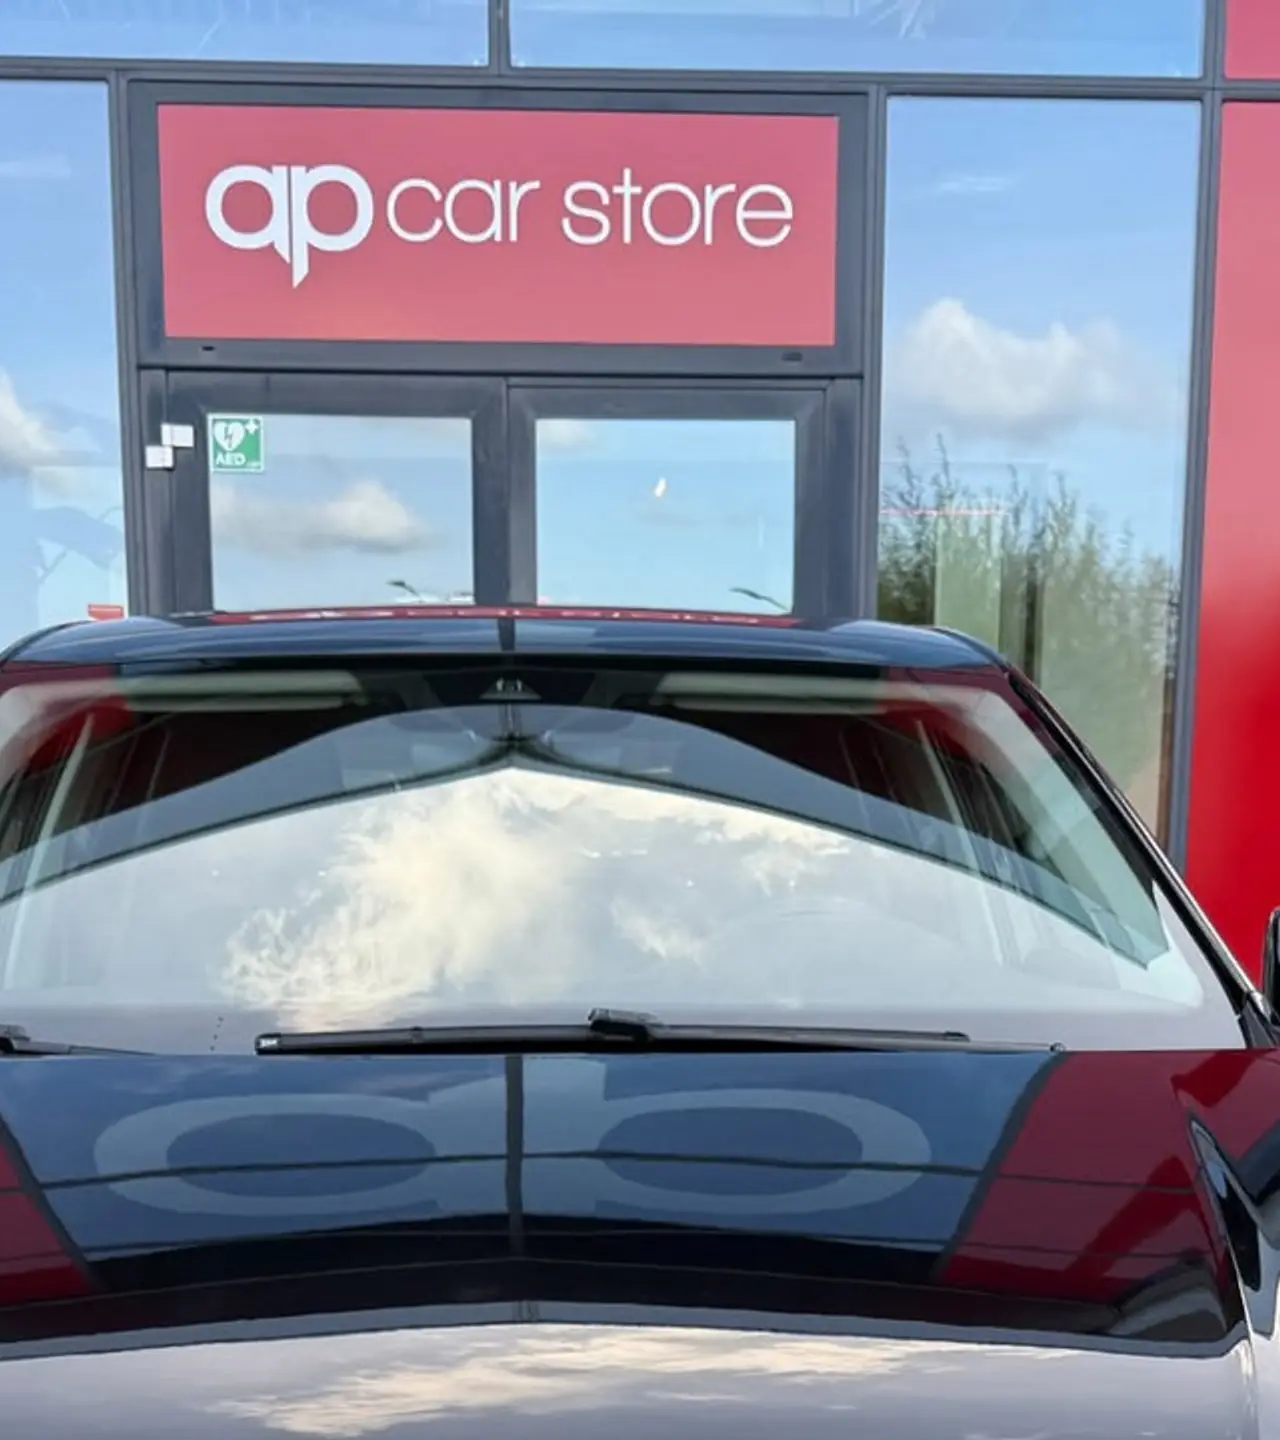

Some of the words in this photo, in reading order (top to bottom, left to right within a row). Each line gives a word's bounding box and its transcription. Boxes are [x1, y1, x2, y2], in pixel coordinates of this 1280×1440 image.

[206, 164, 374, 288] ap
[387, 178, 541, 243] car
[561, 167, 793, 247] store
[216, 452, 246, 466] AED
